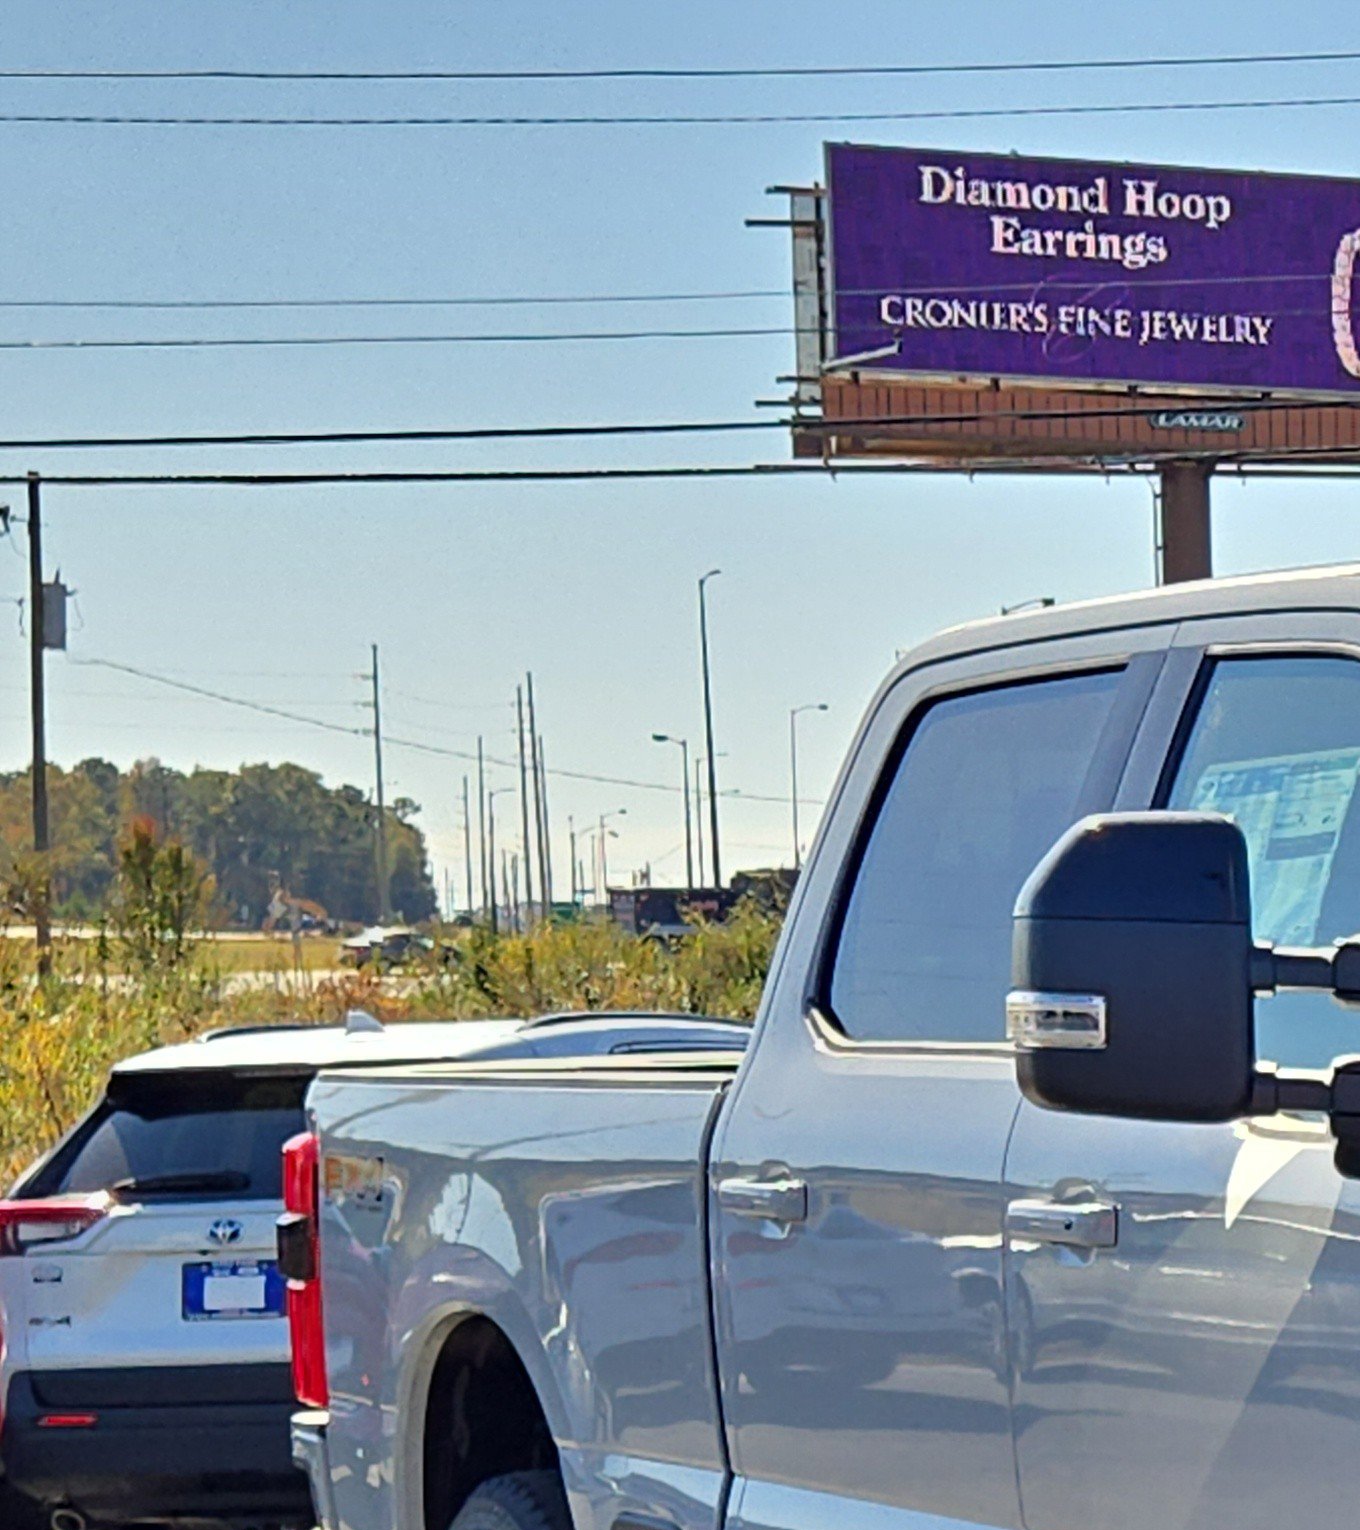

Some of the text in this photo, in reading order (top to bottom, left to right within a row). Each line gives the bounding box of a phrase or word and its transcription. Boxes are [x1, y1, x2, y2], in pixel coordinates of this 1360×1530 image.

[918, 165, 1231, 229] Diamond Hoop
[989, 215, 1168, 270] Earrings
[1057, 305, 1132, 338] FINE
[1137, 309, 1273, 346] JEWELRY
